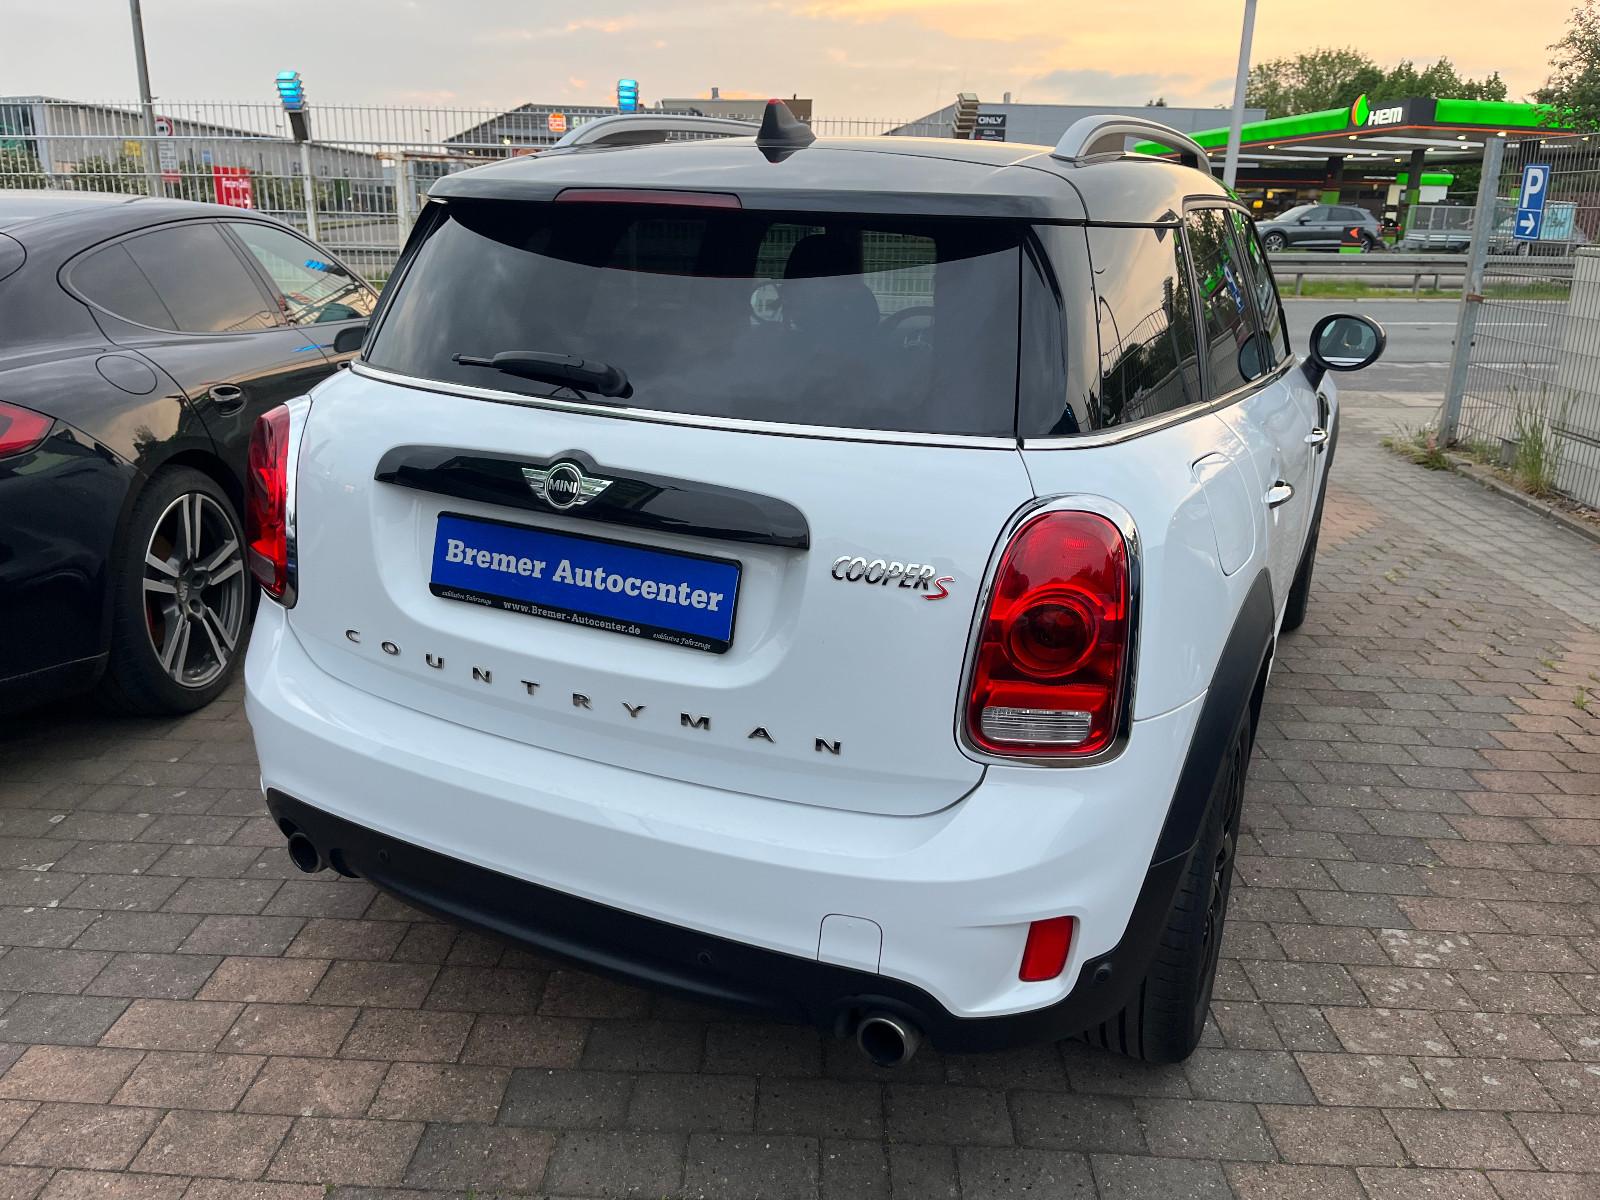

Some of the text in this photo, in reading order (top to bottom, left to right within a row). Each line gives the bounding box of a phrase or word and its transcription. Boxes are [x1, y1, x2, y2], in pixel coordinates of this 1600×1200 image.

[977, 116, 1004, 125] ONLY
[1522, 168, 1545, 209] P
[548, 478, 578, 494] MINI
[445, 538, 724, 613] Bremer Autocenter
[831, 555, 936, 590] COOPER
[503, 601, 641, 635] www.Bremer-Autocenter.de
[345, 628, 842, 755] COUNTRYMAN
